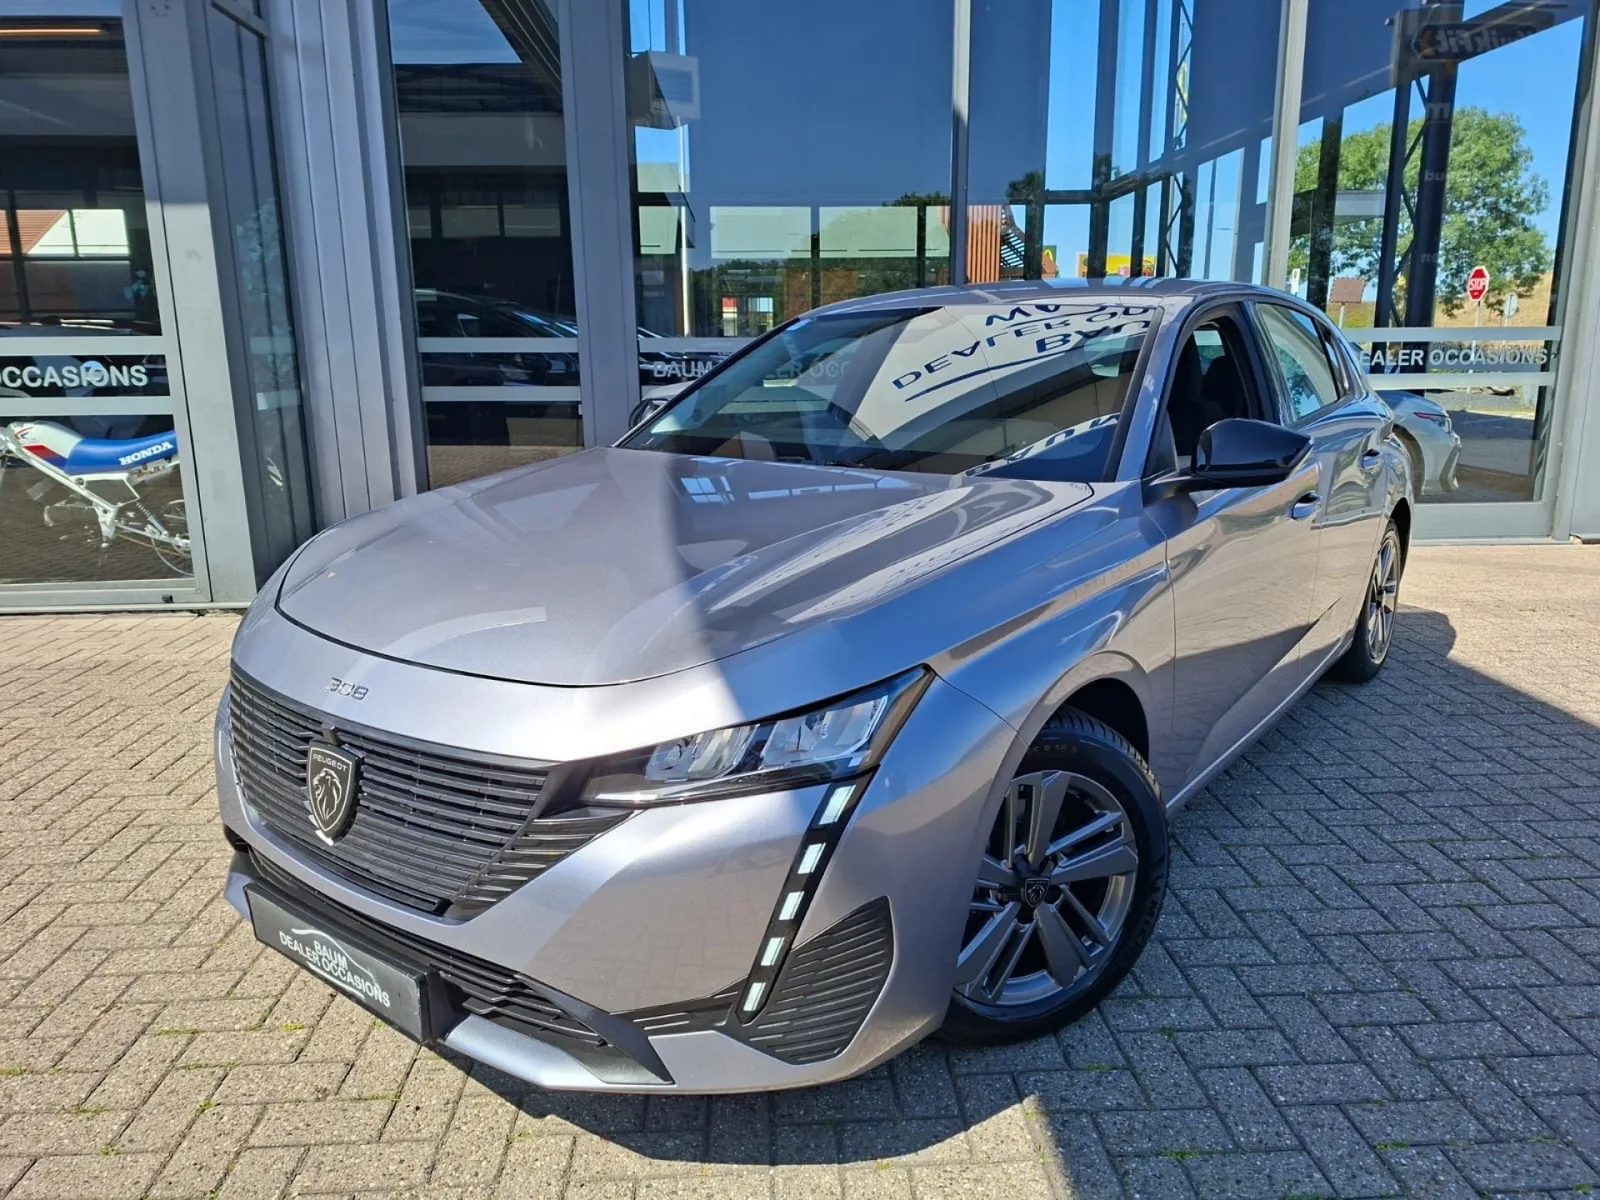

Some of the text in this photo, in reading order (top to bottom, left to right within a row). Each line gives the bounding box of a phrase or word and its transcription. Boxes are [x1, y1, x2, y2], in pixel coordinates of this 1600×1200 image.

[1470, 278, 1486, 291] STOP
[1361, 349, 1548, 366] EALER OCCASIONS
[0, 365, 149, 388] CCASIONS
[118, 441, 174, 466] HONDA
[328, 677, 369, 701] 308
[312, 753, 348, 773] PEUGEOT
[314, 940, 348, 970] BAUM
[279, 931, 391, 1008] DEALER OCCASIONS
